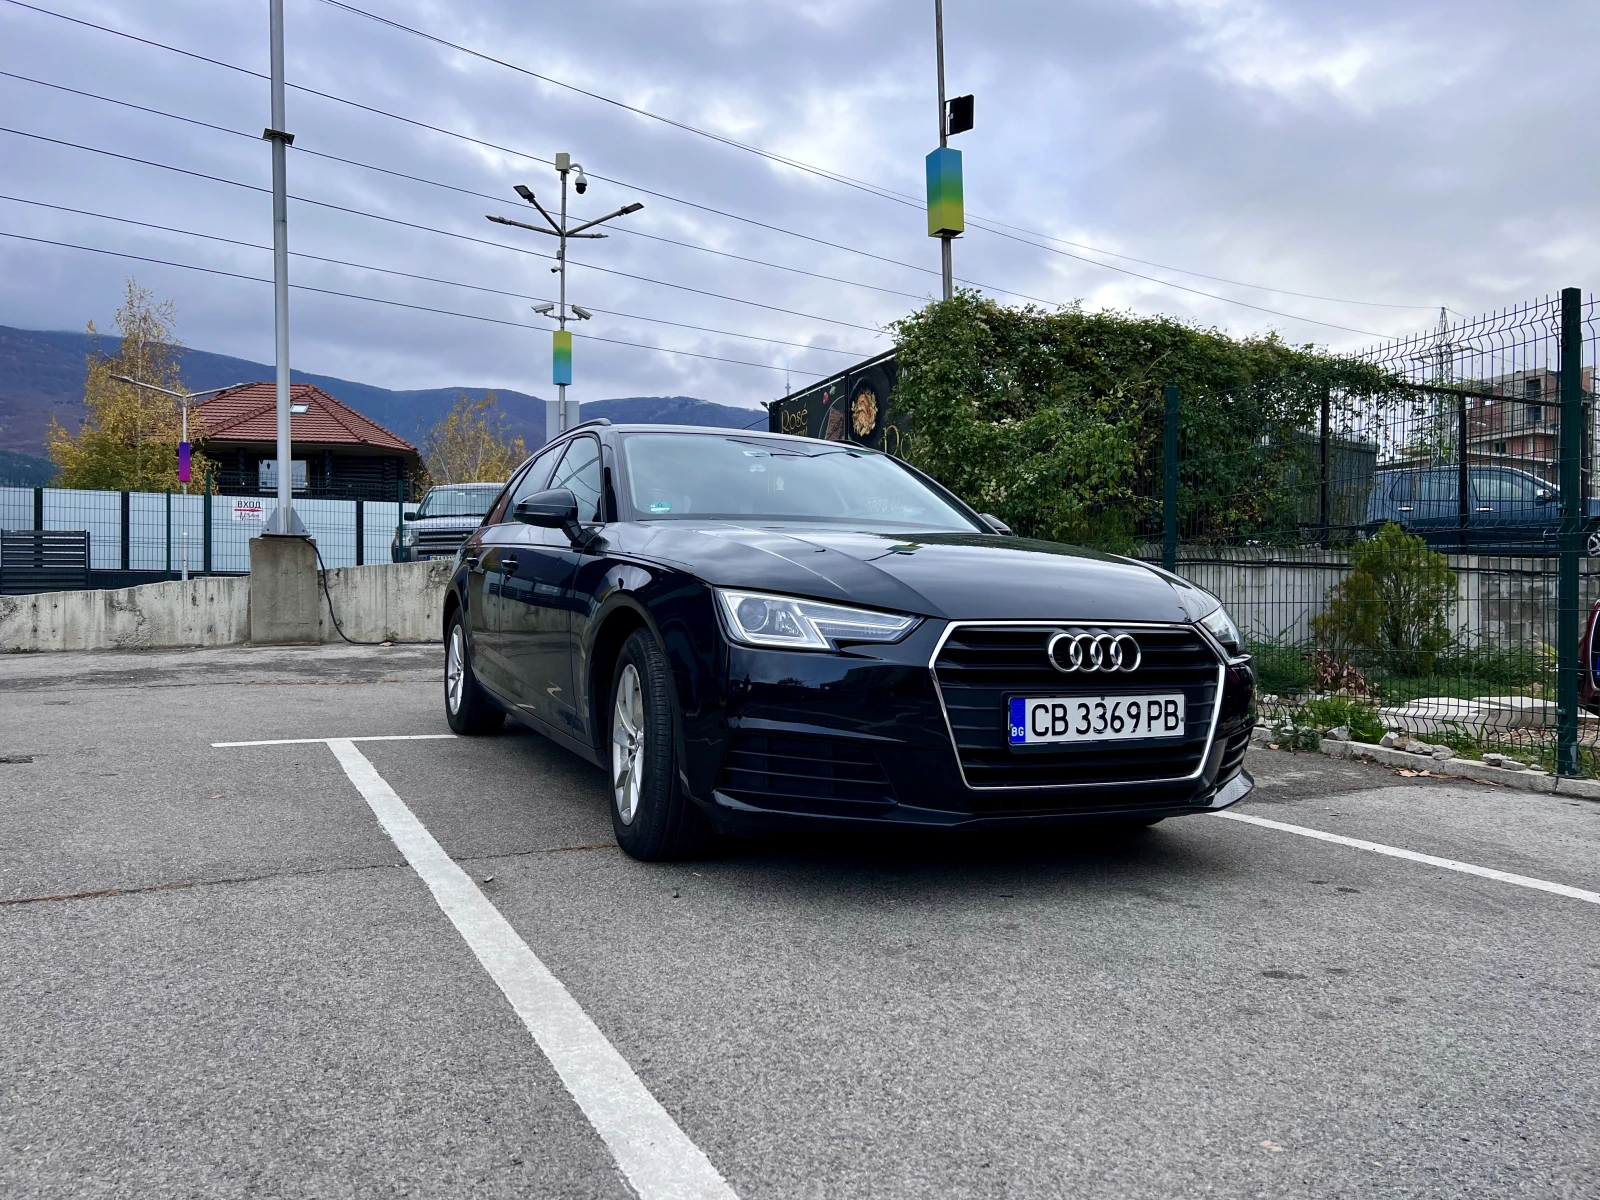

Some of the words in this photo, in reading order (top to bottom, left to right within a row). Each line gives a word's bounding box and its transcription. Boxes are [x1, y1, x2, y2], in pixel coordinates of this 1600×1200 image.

[781, 403, 808, 433] Rosé
[237, 500, 261, 509] ВХОД
[1031, 703, 1069, 737] CB
[1075, 701, 1142, 735] 3369
[1147, 699, 1180, 732] PB
[1011, 726, 1025, 737] BG
